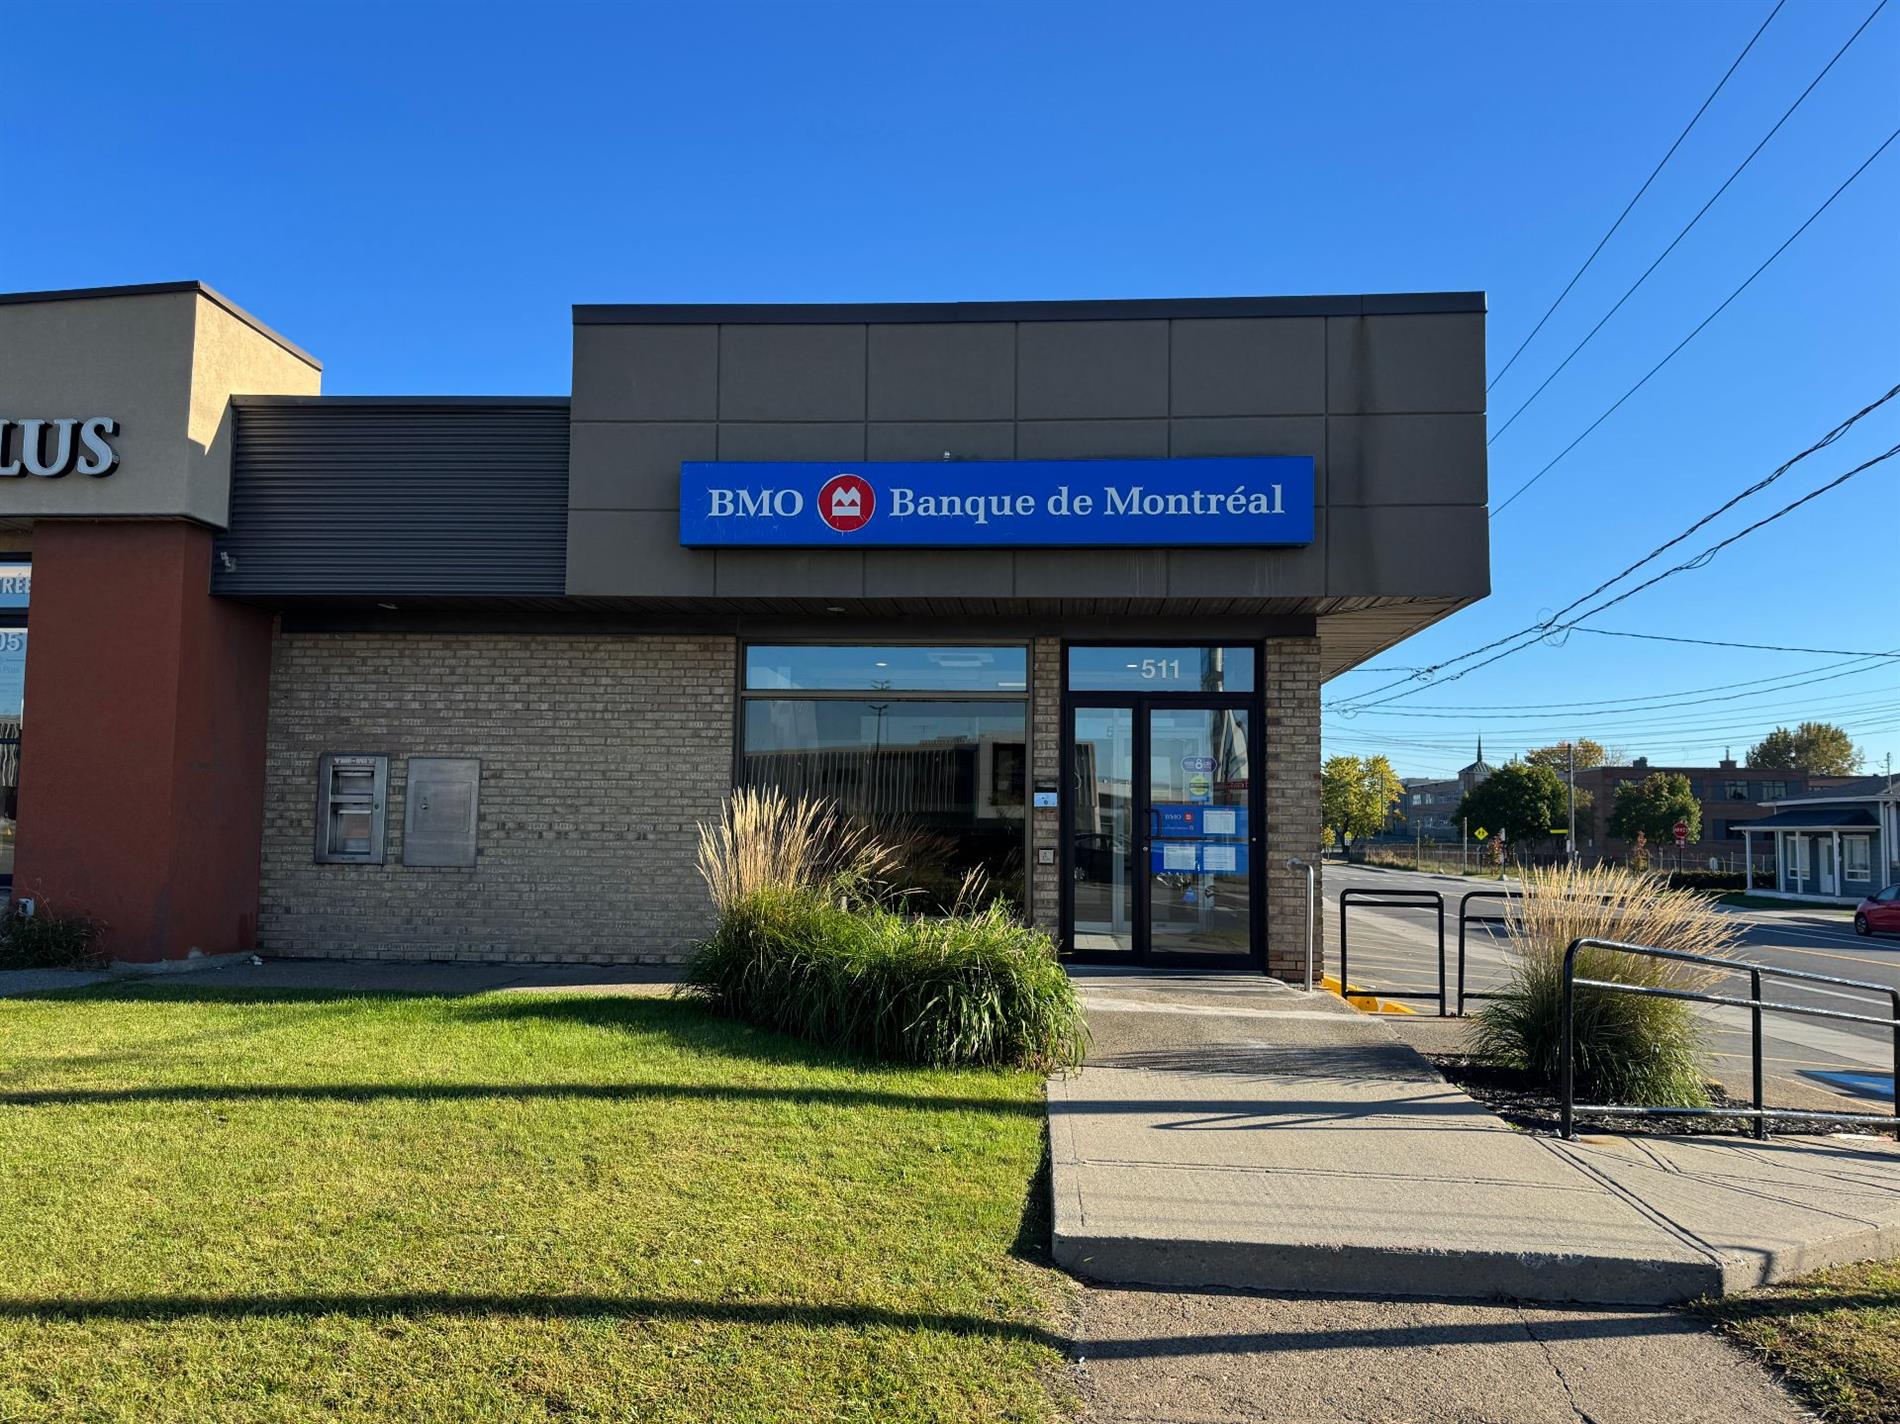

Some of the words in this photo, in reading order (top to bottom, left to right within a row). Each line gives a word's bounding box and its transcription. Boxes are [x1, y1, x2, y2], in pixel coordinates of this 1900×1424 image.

[707, 487, 804, 517] BMO
[890, 487, 1035, 524] Banque
[1047, 486, 1093, 516] de
[1103, 484, 1286, 516] Montréal
[1141, 659, 1180, 679] 511
